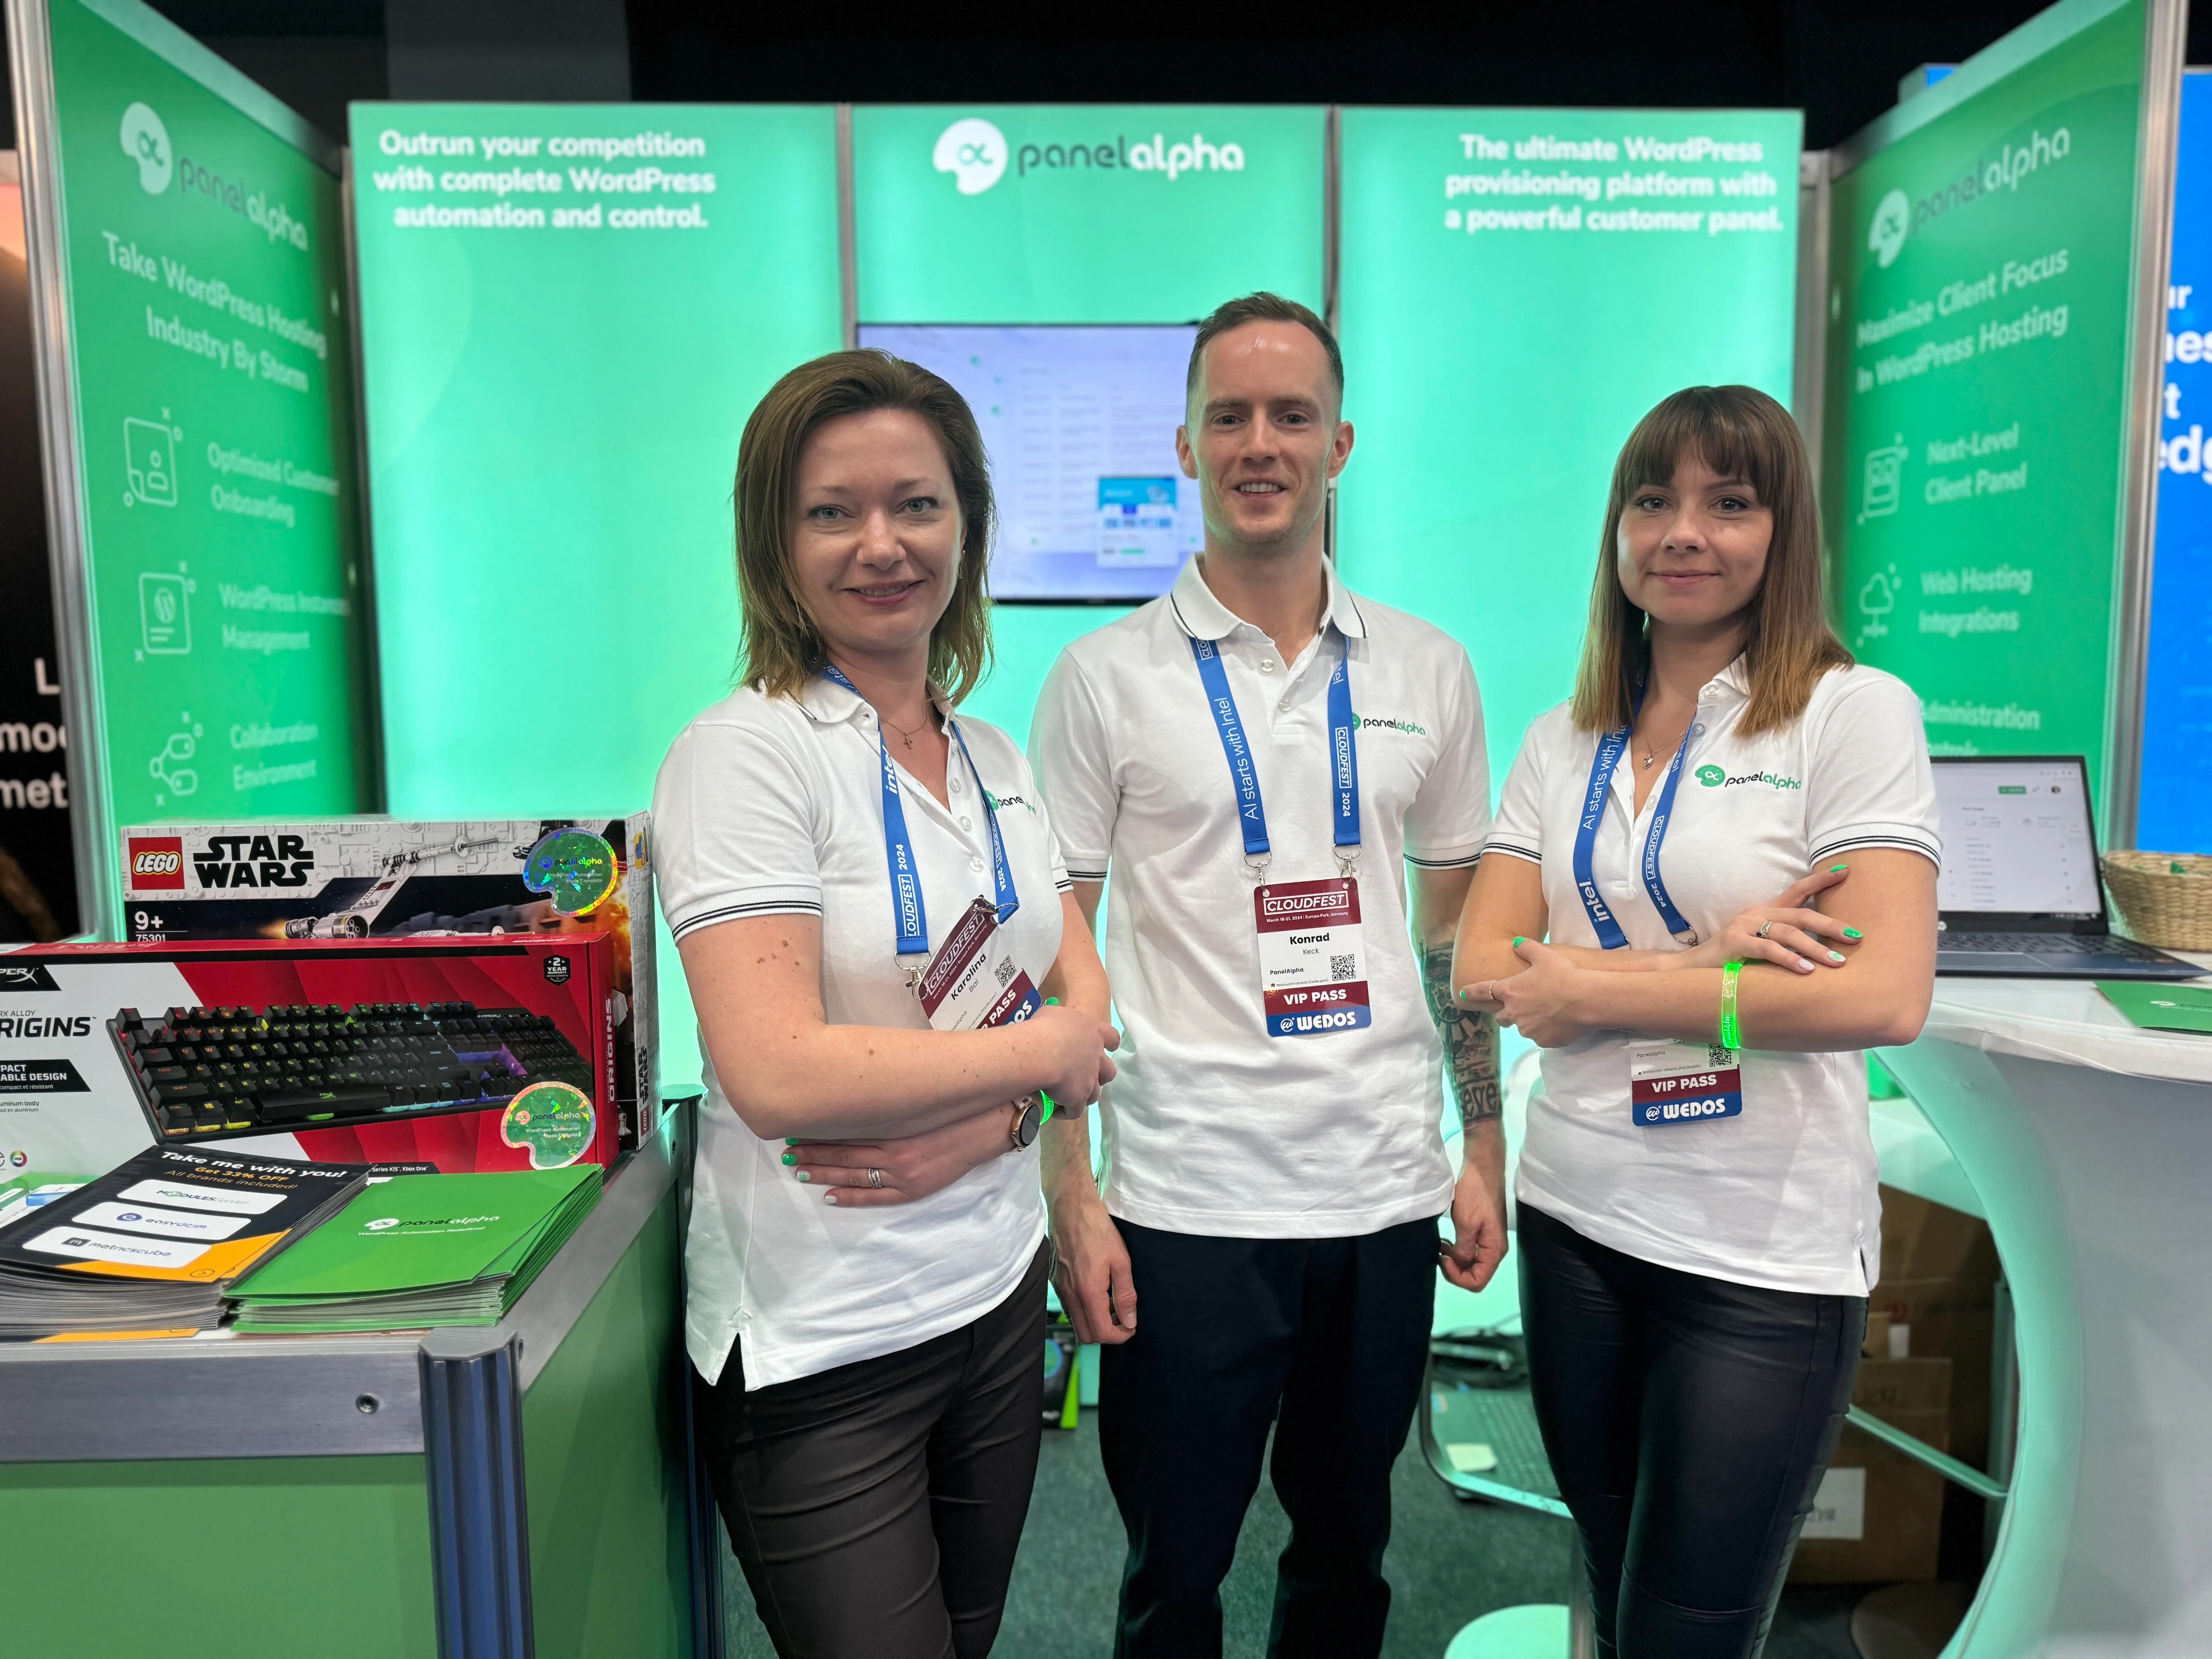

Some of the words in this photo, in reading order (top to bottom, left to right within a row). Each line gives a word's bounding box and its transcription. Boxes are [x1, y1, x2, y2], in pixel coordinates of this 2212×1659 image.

[380, 129, 475, 156] Outrun
[481, 134, 542, 161] your
[548, 131, 705, 162] competition
[1018, 133, 1245, 181] panelalpha
[1459, 134, 1508, 160] The
[1514, 135, 1618, 161] ultimate
[1625, 136, 1763, 161] WordPress
[373, 165, 434, 192] with
[440, 166, 563, 197] complete
[568, 167, 716, 193] WordPress
[1445, 170, 1601, 201] provisioning
[1606, 171, 1714, 200] platform
[1719, 171, 1777, 196] with
[1912, 127, 2070, 236] panelalpha
[180, 157, 309, 252] panelalpha
[393, 202, 544, 228] automation
[552, 203, 601, 228] and
[608, 203, 708, 228] control.
[1444, 209, 1462, 229] a
[1467, 206, 1581, 234] powerful
[1587, 207, 1704, 231] customer
[1709, 207, 1784, 236] panel.
[102, 230, 158, 283] Take
[161, 255, 264, 328] WordPress
[267, 304, 327, 360] Hosting
[1856, 300, 1934, 349] Maximize
[1938, 271, 1997, 317] Client
[2001, 249, 2069, 295] Focus
[147, 305, 229, 369] Industry
[234, 339, 257, 379] By
[260, 350, 309, 393] Storm
[1875, 334, 1973, 386] WordPress
[1978, 304, 2068, 353] Hosting
[1927, 422, 2019, 466] Next-Level
[207, 441, 282, 484] Optimized
[1925, 472, 1973, 505] Client
[1976, 461, 2028, 496] Panel
[211, 484, 295, 528] Onboarding
[1921, 569, 1958, 596] Web
[1961, 564, 2033, 596] Hosting
[218, 582, 295, 613] WordPress
[1919, 606, 2020, 638] Integrations
[222, 624, 311, 654] Management
[1214, 697, 1234, 724] Intel
[230, 721, 319, 750] Collaboration
[1363, 718, 1426, 736] panelalpha
[1225, 727, 1243, 756] with
[1337, 729, 1351, 786] CLOUDFEST
[1601, 745, 1619, 771] with
[233, 759, 316, 791] Environment
[1237, 759, 1255, 799] starts
[1725, 771, 1801, 790] panelalpha
[1341, 792, 1351, 817] 2024
[1589, 773, 1606, 812] starts
[1244, 805, 1259, 820] AI
[1583, 814, 1596, 830] AI
[193, 835, 314, 862] STAR
[896, 843, 908, 871] 2024
[1646, 818, 1662, 877] CLOUDFEST
[135, 853, 180, 874] LEGO
[194, 862, 314, 888] WARS
[998, 867, 1007, 891] 2024
[903, 877, 915, 936] LOUDFEST
[1267, 894, 1345, 912] CLOUDFEST
[1651, 883, 1668, 908] 2024
[134, 911, 164, 930] 9+
[136, 934, 166, 942] 75301
[1290, 933, 1330, 945] Konrad
[553, 957, 561, 966] 2
[930, 915, 980, 989] CLOUDFEST
[951, 953, 987, 1001] Karolina
[969, 979, 979, 992] Bal
[989, 989, 1016, 1025] PASS
[1283, 993, 1308, 1005] VIP
[1311, 989, 1347, 1002] PASS
[1297, 1012, 1356, 1031] WEDOS
[606, 998, 615, 1101] ORIGINS
[29, 1073, 67, 1081] DESIGN
[1652, 1080, 1676, 1093] VIP
[1680, 1075, 1717, 1089] PASS
[532, 1111, 580, 1122] panelalpha
[1663, 1098, 1726, 1120] WEDOS
[161, 1152, 208, 1164] Take
[213, 1160, 244, 1170] me
[250, 1164, 296, 1175] with
[299, 1170, 349, 1178] you!
[225, 1170, 256, 1179] 33%
[186, 1173, 234, 1184] brands
[235, 1178, 298, 1190] included!
[145, 1218, 207, 1230] easydcim
[398, 1216, 500, 1228] panelalpha
[88, 1242, 172, 1257] metricscube
